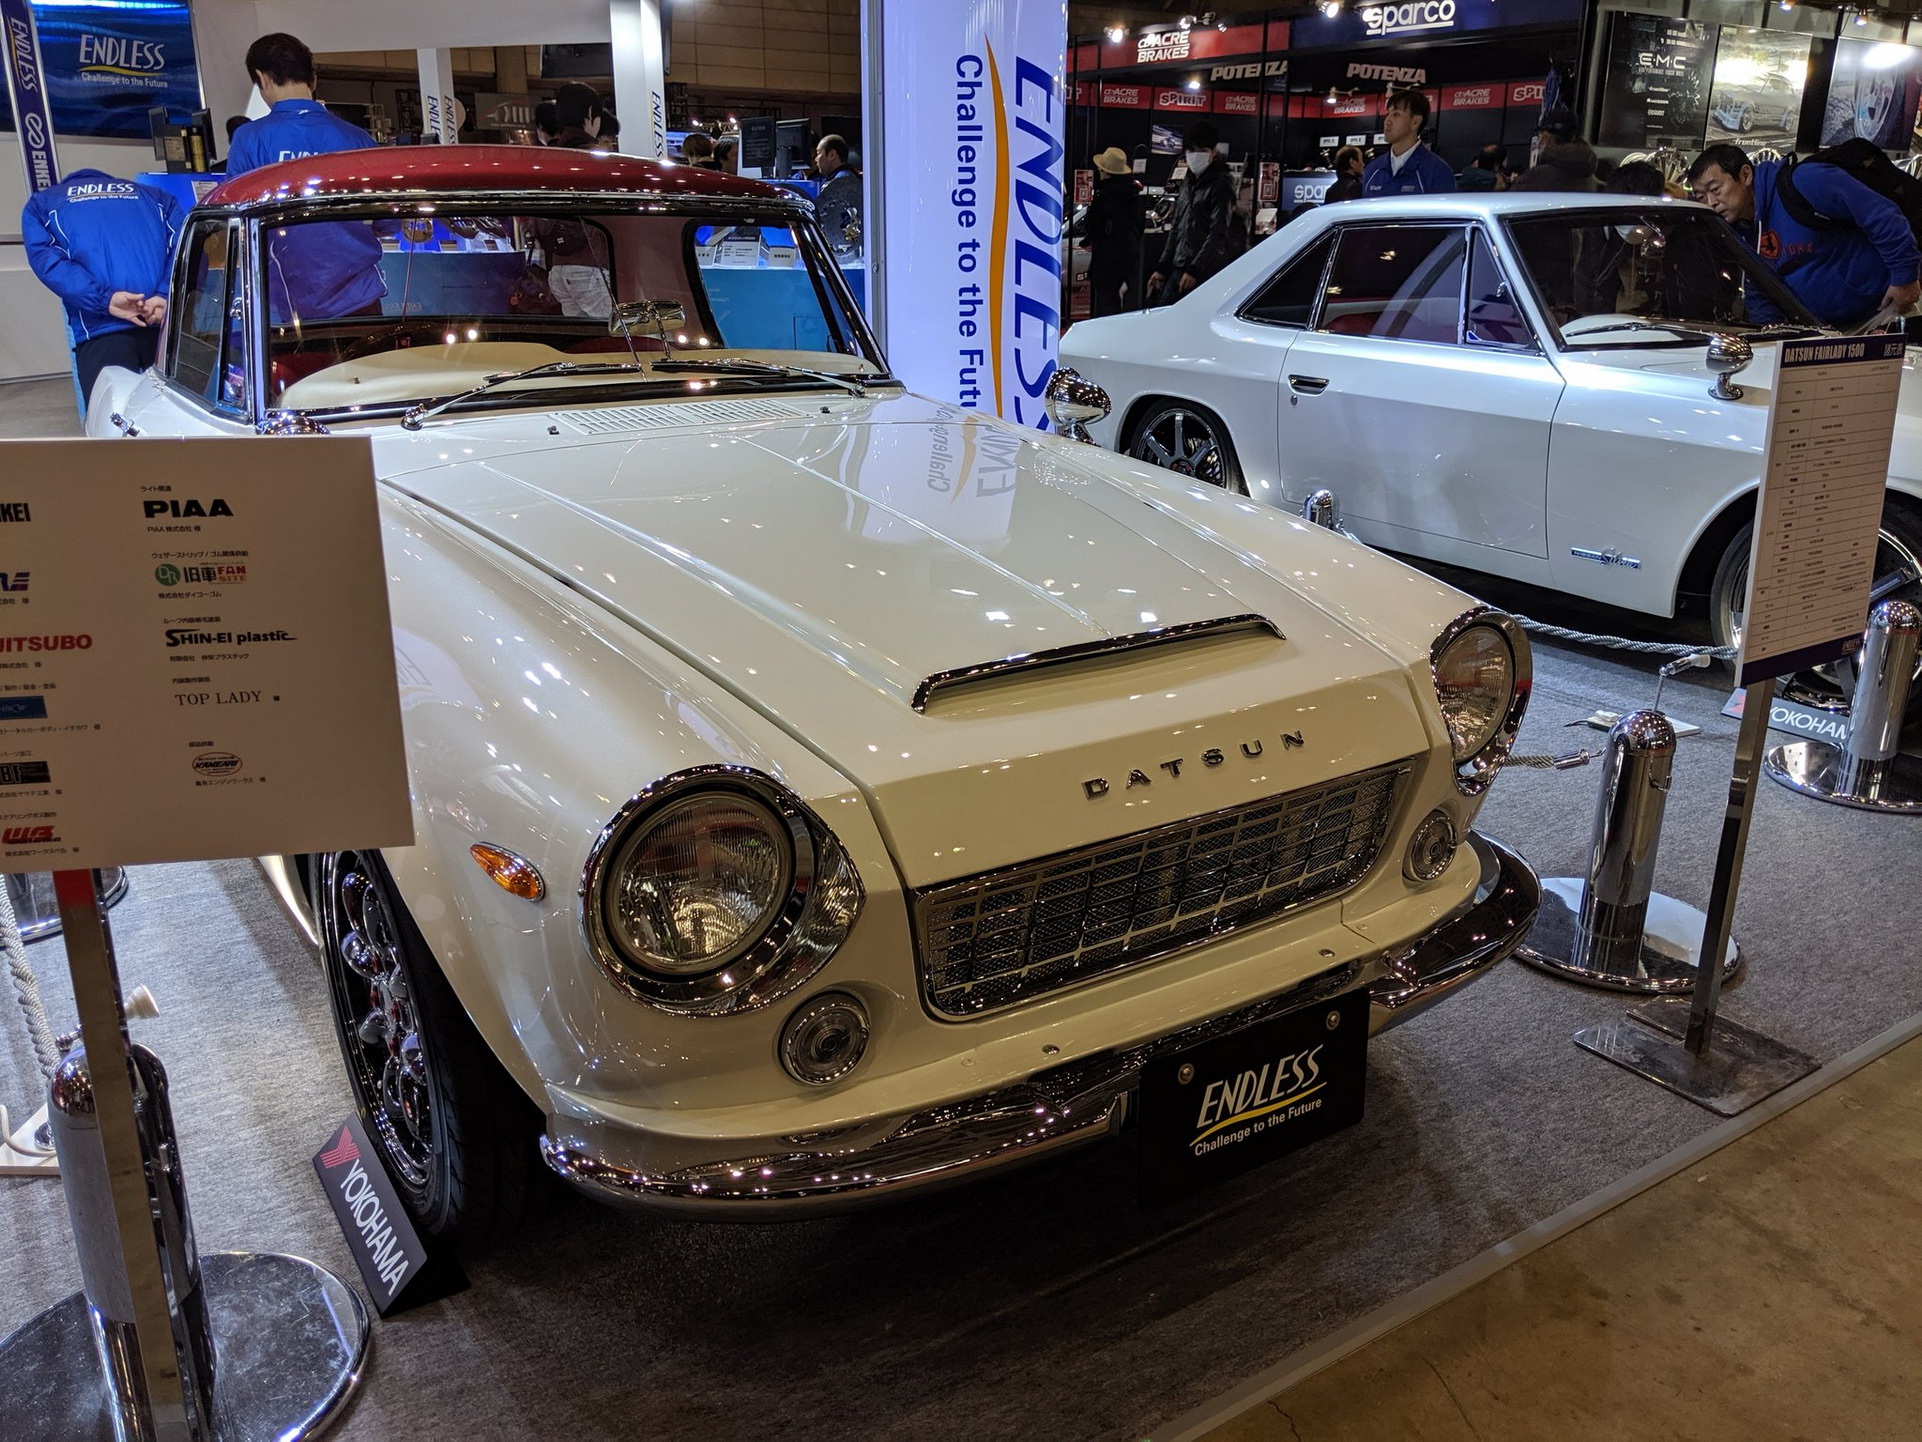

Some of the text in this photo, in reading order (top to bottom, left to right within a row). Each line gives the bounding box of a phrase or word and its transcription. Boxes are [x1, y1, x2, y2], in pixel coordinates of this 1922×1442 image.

[1362, 0, 1456, 35] sparco
[11, 17, 38, 93] ENDLESS
[79, 34, 165, 70] ENDLESS
[1137, 46, 1190, 63] BRAKES
[81, 72, 168, 88] Challenge to the Future
[1346, 63, 1427, 84] POTENZA
[1104, 96, 1139, 104] BRAKES
[1159, 91, 1206, 106] SPIRIT
[1453, 96, 1490, 106] BRAKES
[1513, 85, 1545, 101] SPI
[1225, 103, 1256, 112] BRAKES
[652, 91, 664, 158] ENDLESS
[953, 54, 983, 229] Challenge
[67, 183, 134, 196] ENDLESS
[958, 239, 983, 273] to
[958, 283, 983, 338] the
[1784, 347, 1814, 363] DATSUN
[1814, 344, 1848, 360] FAIRLADY
[143, 499, 234, 518] PIAA
[183, 565, 247, 583] 旧車 FAN
[165, 628, 298, 647] SHIN-EI plastic
[175, 693, 210, 706] TOP
[216, 691, 262, 704] LADY
[1081, 730, 1304, 800] DATSUN
[1196, 1043, 1324, 1129] ENDLESS
[1194, 1098, 1322, 1156] Challenge to the Future
[340, 1158, 409, 1297] YOKOHAMA
